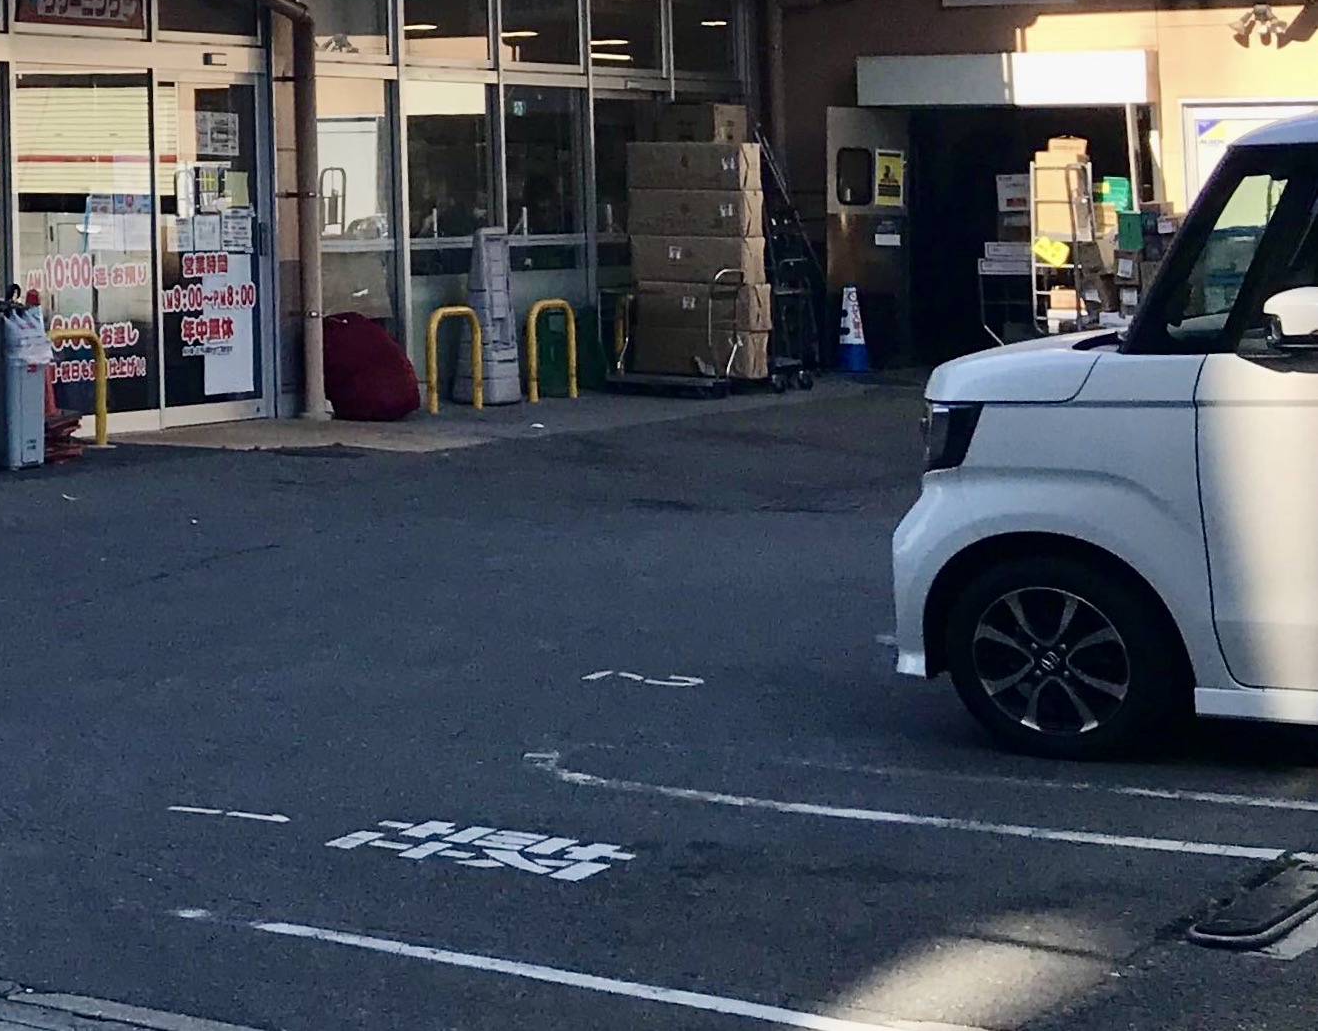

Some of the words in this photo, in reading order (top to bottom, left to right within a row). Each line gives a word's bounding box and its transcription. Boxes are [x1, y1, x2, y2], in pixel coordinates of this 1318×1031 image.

[183, 252, 229, 277] 営業時間
[181, 317, 234, 344] 年中無休
